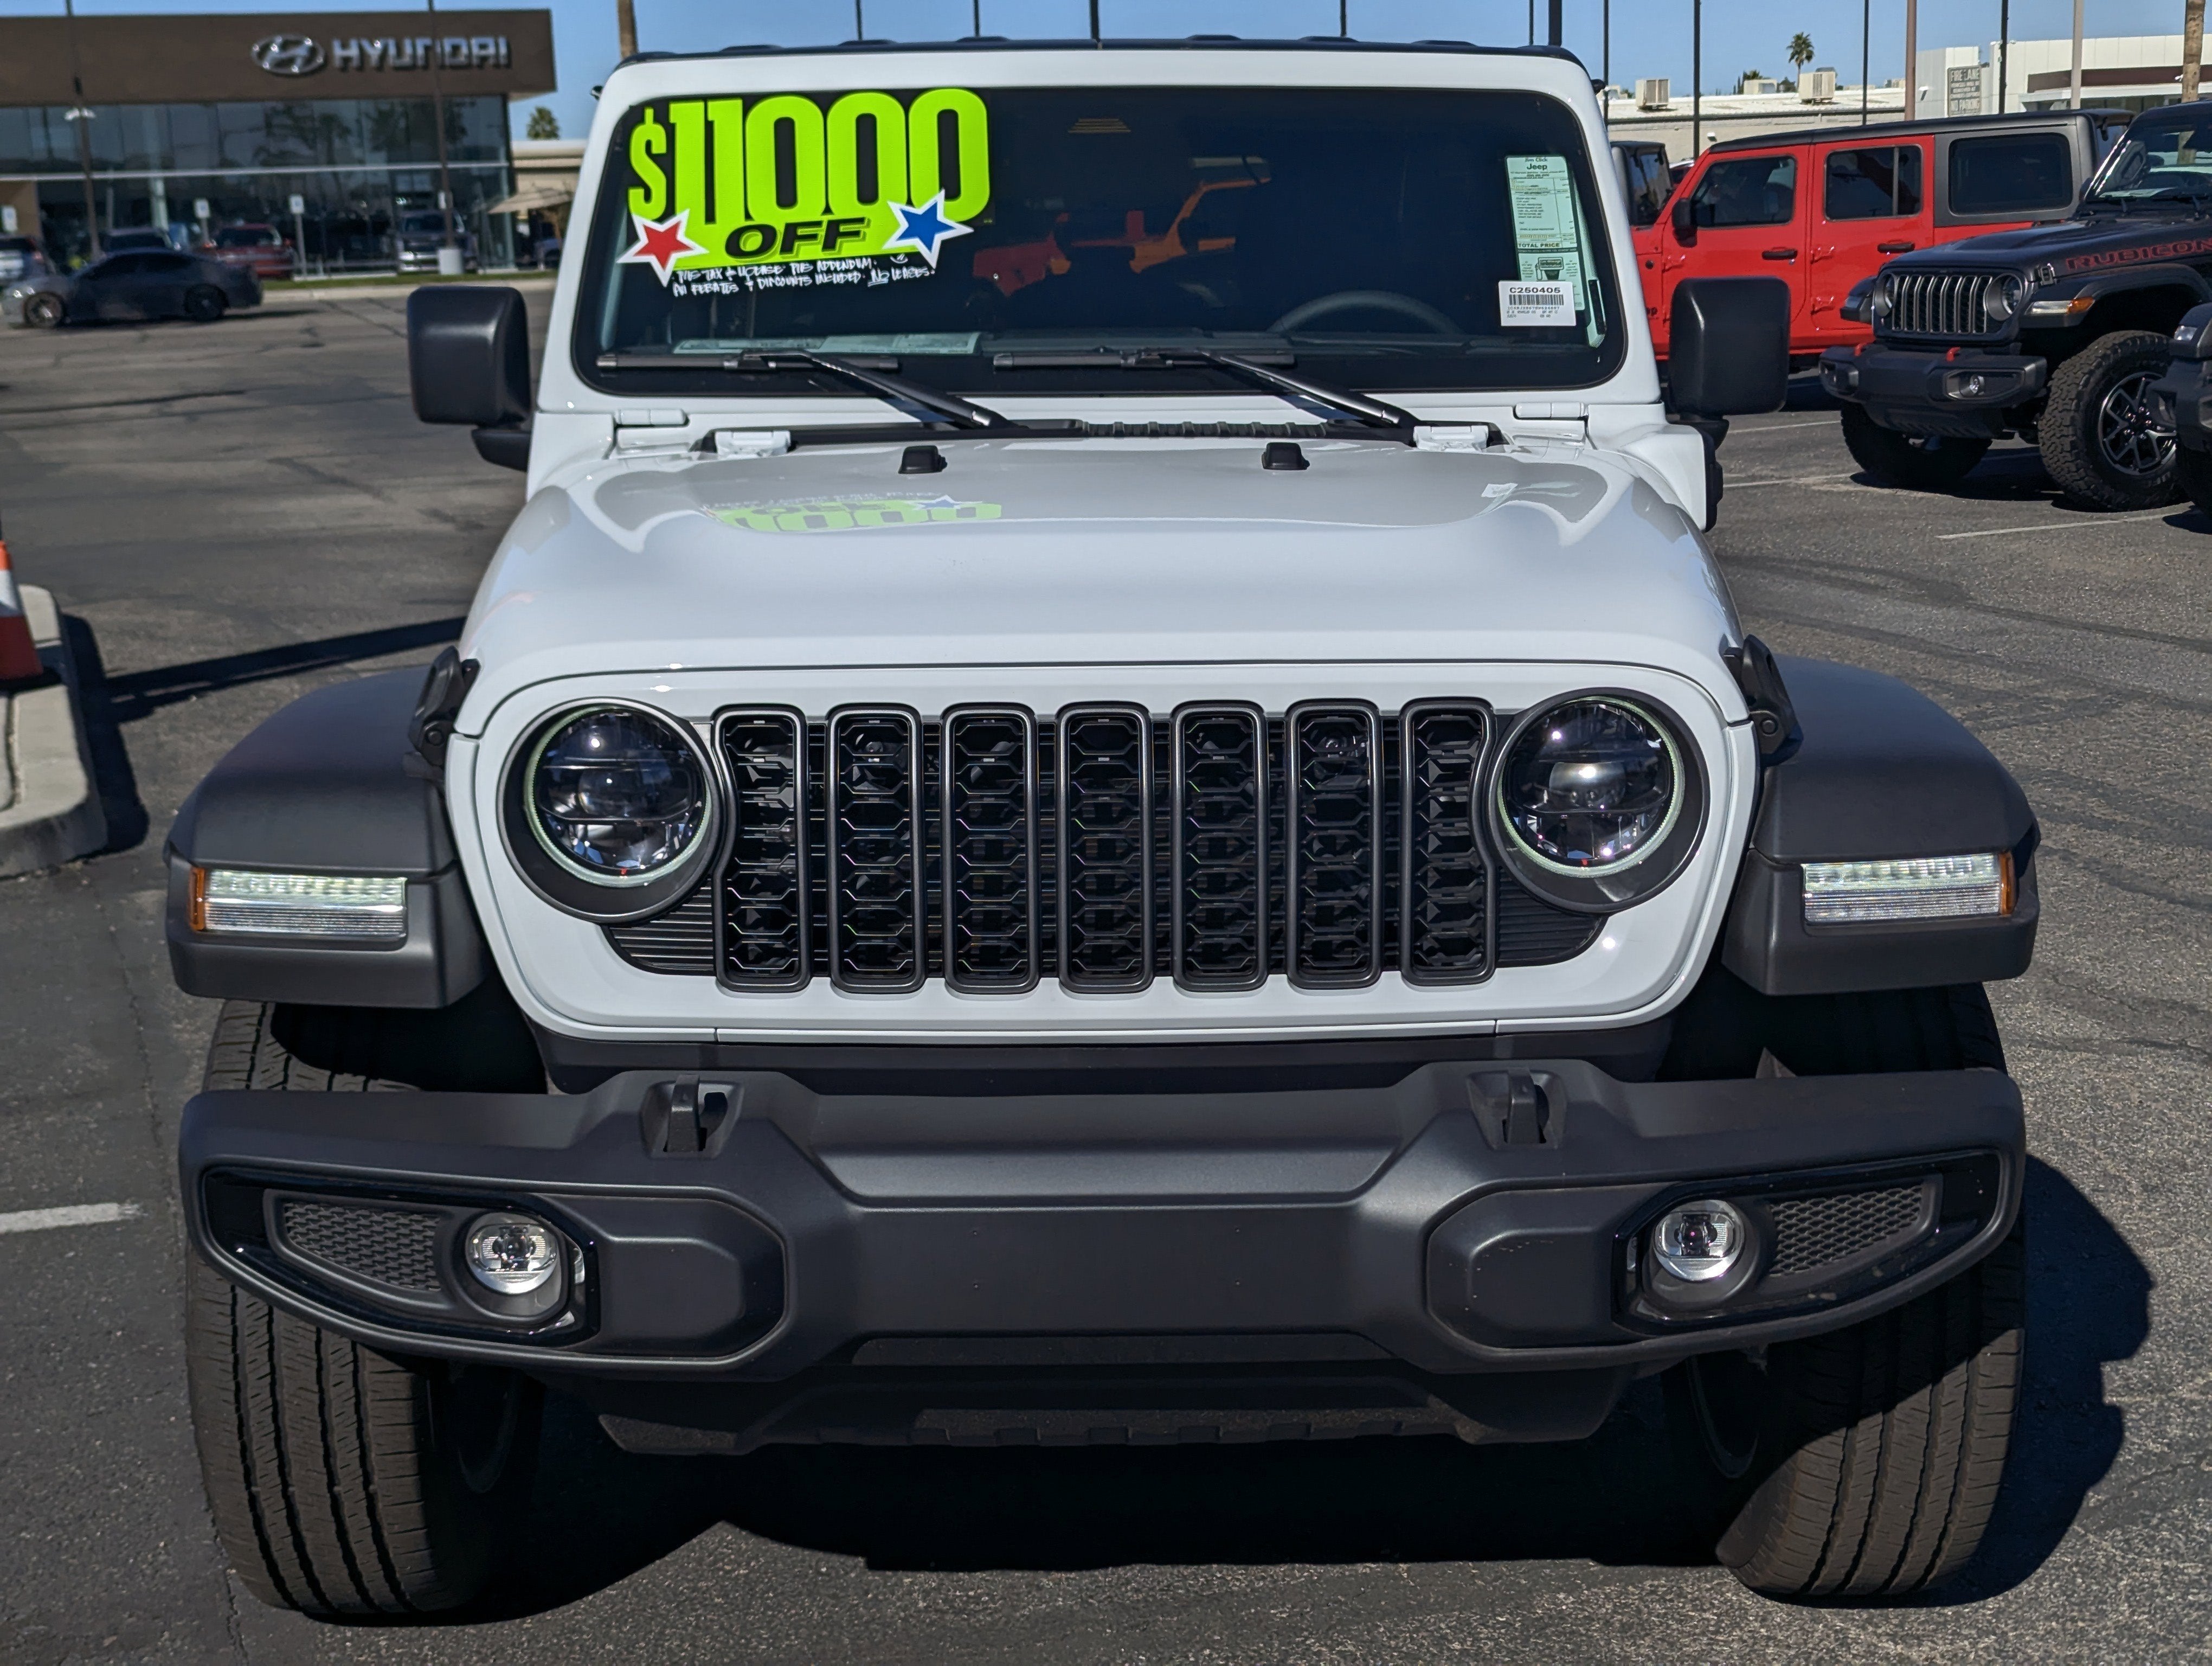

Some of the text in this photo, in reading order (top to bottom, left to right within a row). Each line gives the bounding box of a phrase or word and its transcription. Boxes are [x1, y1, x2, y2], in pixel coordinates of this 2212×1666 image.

[332, 36, 508, 69] HYUNDAI
[628, 88, 991, 224] $11000
[724, 217, 870, 259] OFF
[690, 281, 740, 296] REBATES
[870, 268, 890, 283] NO
[701, 268, 723, 281] TAX
